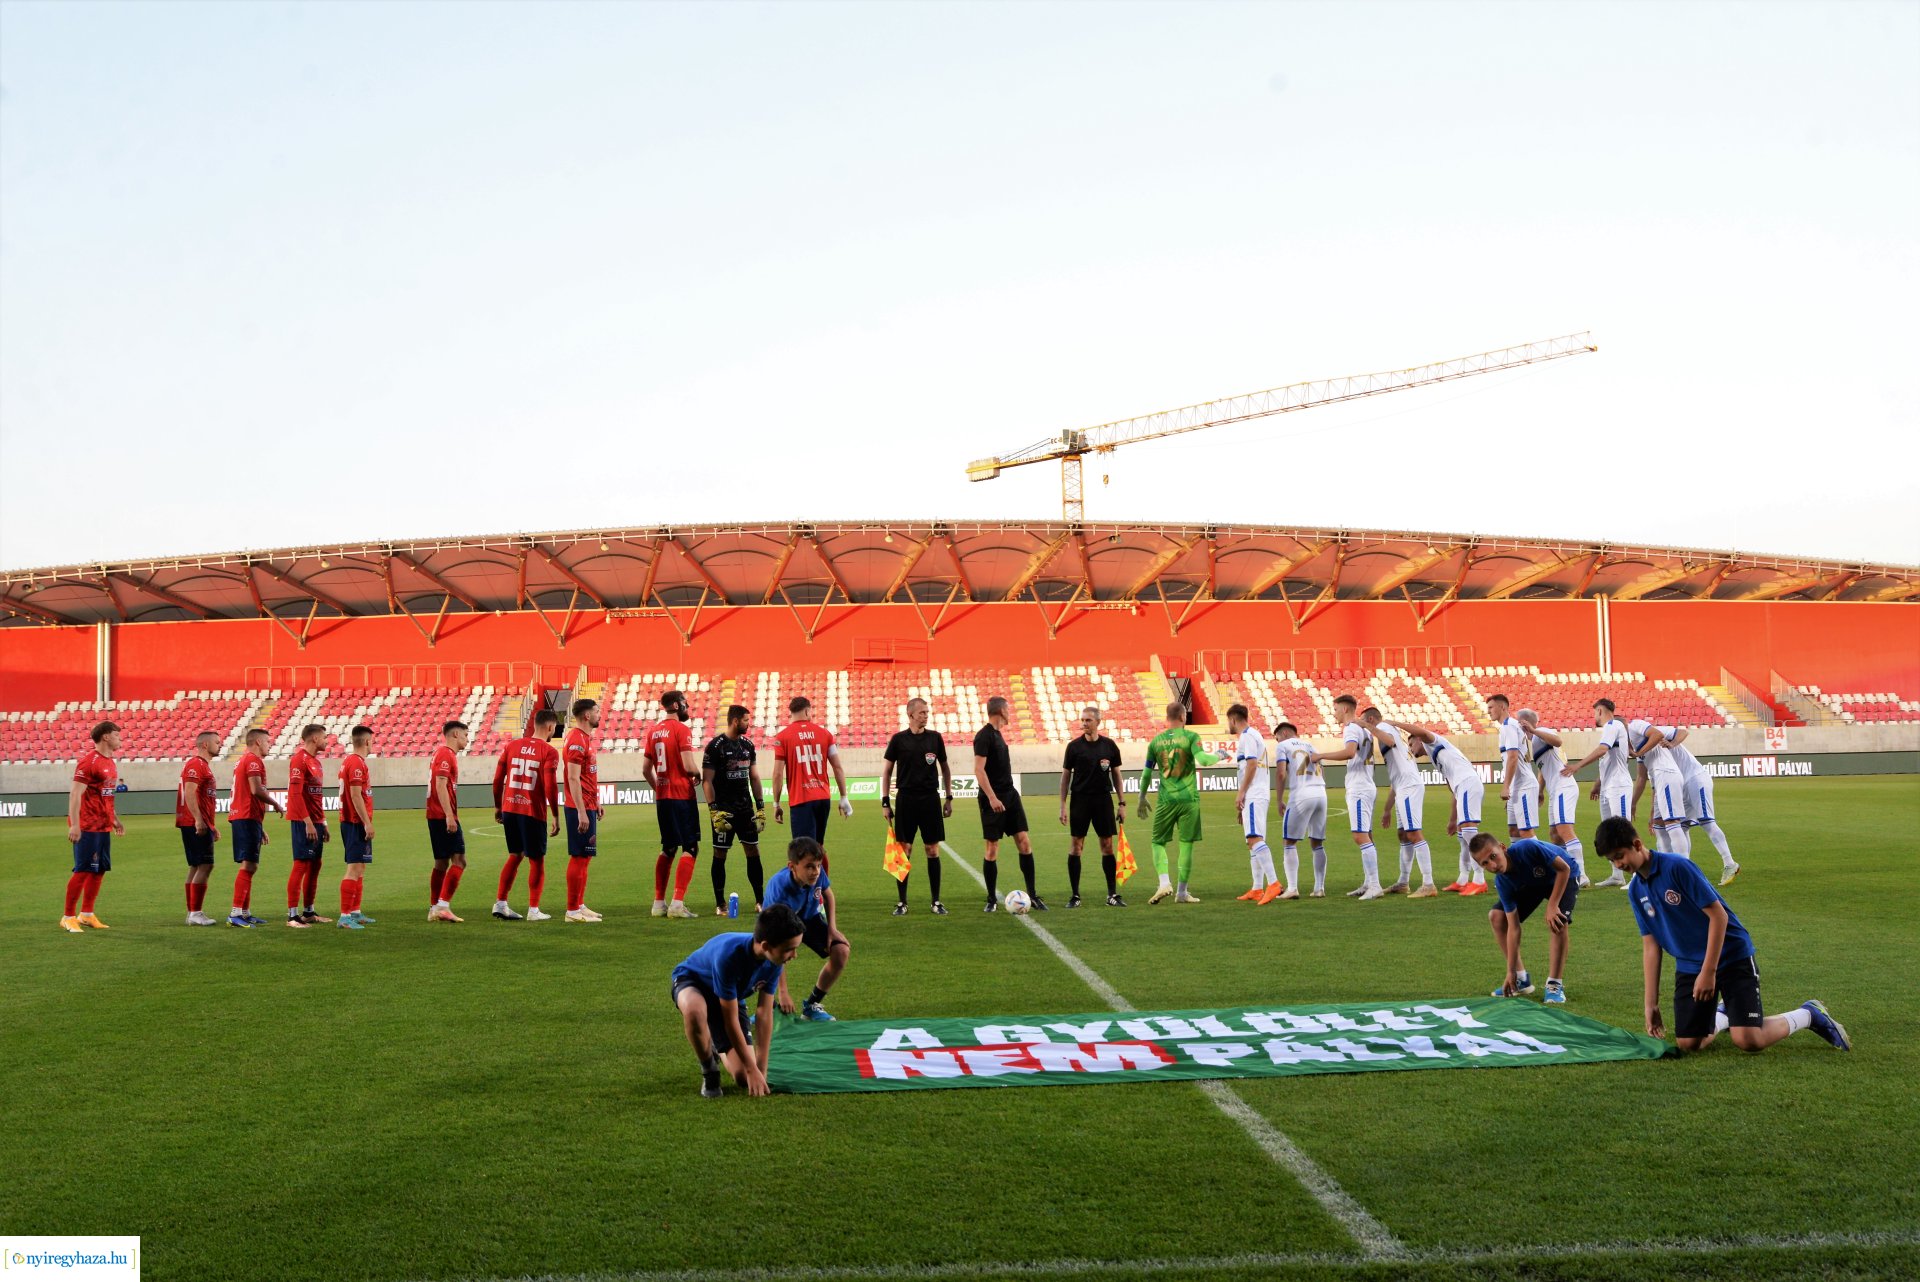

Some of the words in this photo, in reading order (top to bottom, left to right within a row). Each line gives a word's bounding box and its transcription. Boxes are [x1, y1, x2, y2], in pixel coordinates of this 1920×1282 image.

[798, 731, 815, 740] BAKI
[1766, 728, 1785, 739] B4
[520, 746, 536, 756] GÁL
[655, 742, 667, 773] 9
[796, 744, 823, 776] 44
[1742, 757, 1776, 776] NEM
[1778, 760, 1812, 775] PÁLYA!
[509, 757, 541, 791] 25
[853, 784, 875, 792] LIGA
[1203, 775, 1238, 791] PÁLYA!
[617, 787, 654, 804] PÁLYA!
[717, 832, 727, 843] 21
[870, 1028, 944, 1050] A
[867, 1043, 1172, 1079] NEM
[1177, 1031, 1568, 1067] PÁLYA!
